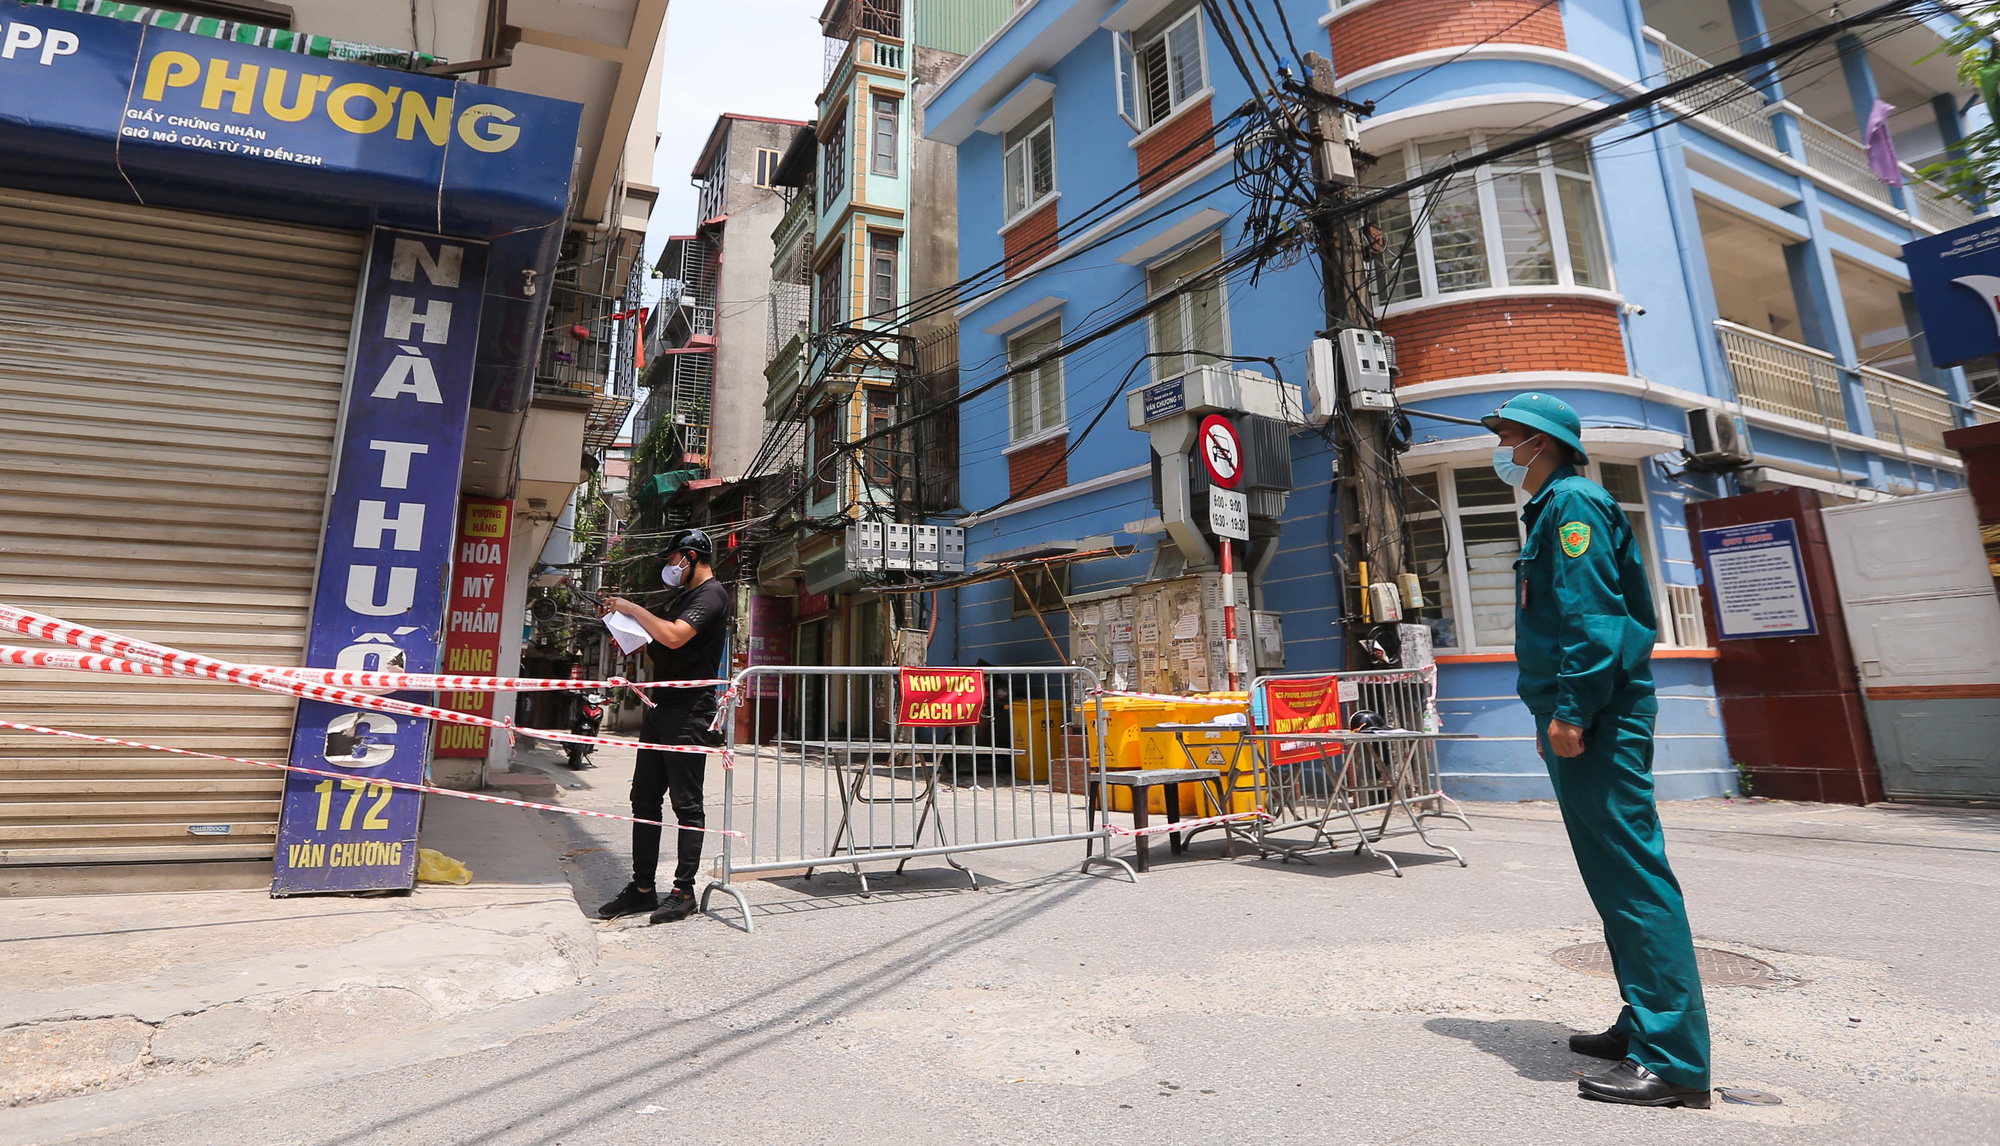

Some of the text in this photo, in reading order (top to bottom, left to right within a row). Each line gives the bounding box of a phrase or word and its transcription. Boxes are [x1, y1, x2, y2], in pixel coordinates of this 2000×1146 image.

[0, 21, 80, 66] PP
[142, 50, 521, 153] PHƯƠNG
[126, 107, 267, 142] GIẤY CHỨNG NHẬN
[121, 126, 150, 139] GIỜ
[152, 130, 178, 143] MỞ
[242, 145, 260, 156] 7H
[370, 238, 464, 404] NHÀ
[461, 539, 502, 565] HÓA
[462, 573, 495, 598] MỸ
[450, 603, 499, 634] PHẨM
[448, 643, 492, 673] HÀNG
[908, 674, 976, 696] KHU VỰC
[908, 699, 977, 720] CÁCH LY
[1276, 719, 1291, 733] KHU
[314, 777, 395, 831] 172
[288, 838, 403, 869] VĂN CHƯƠNG
